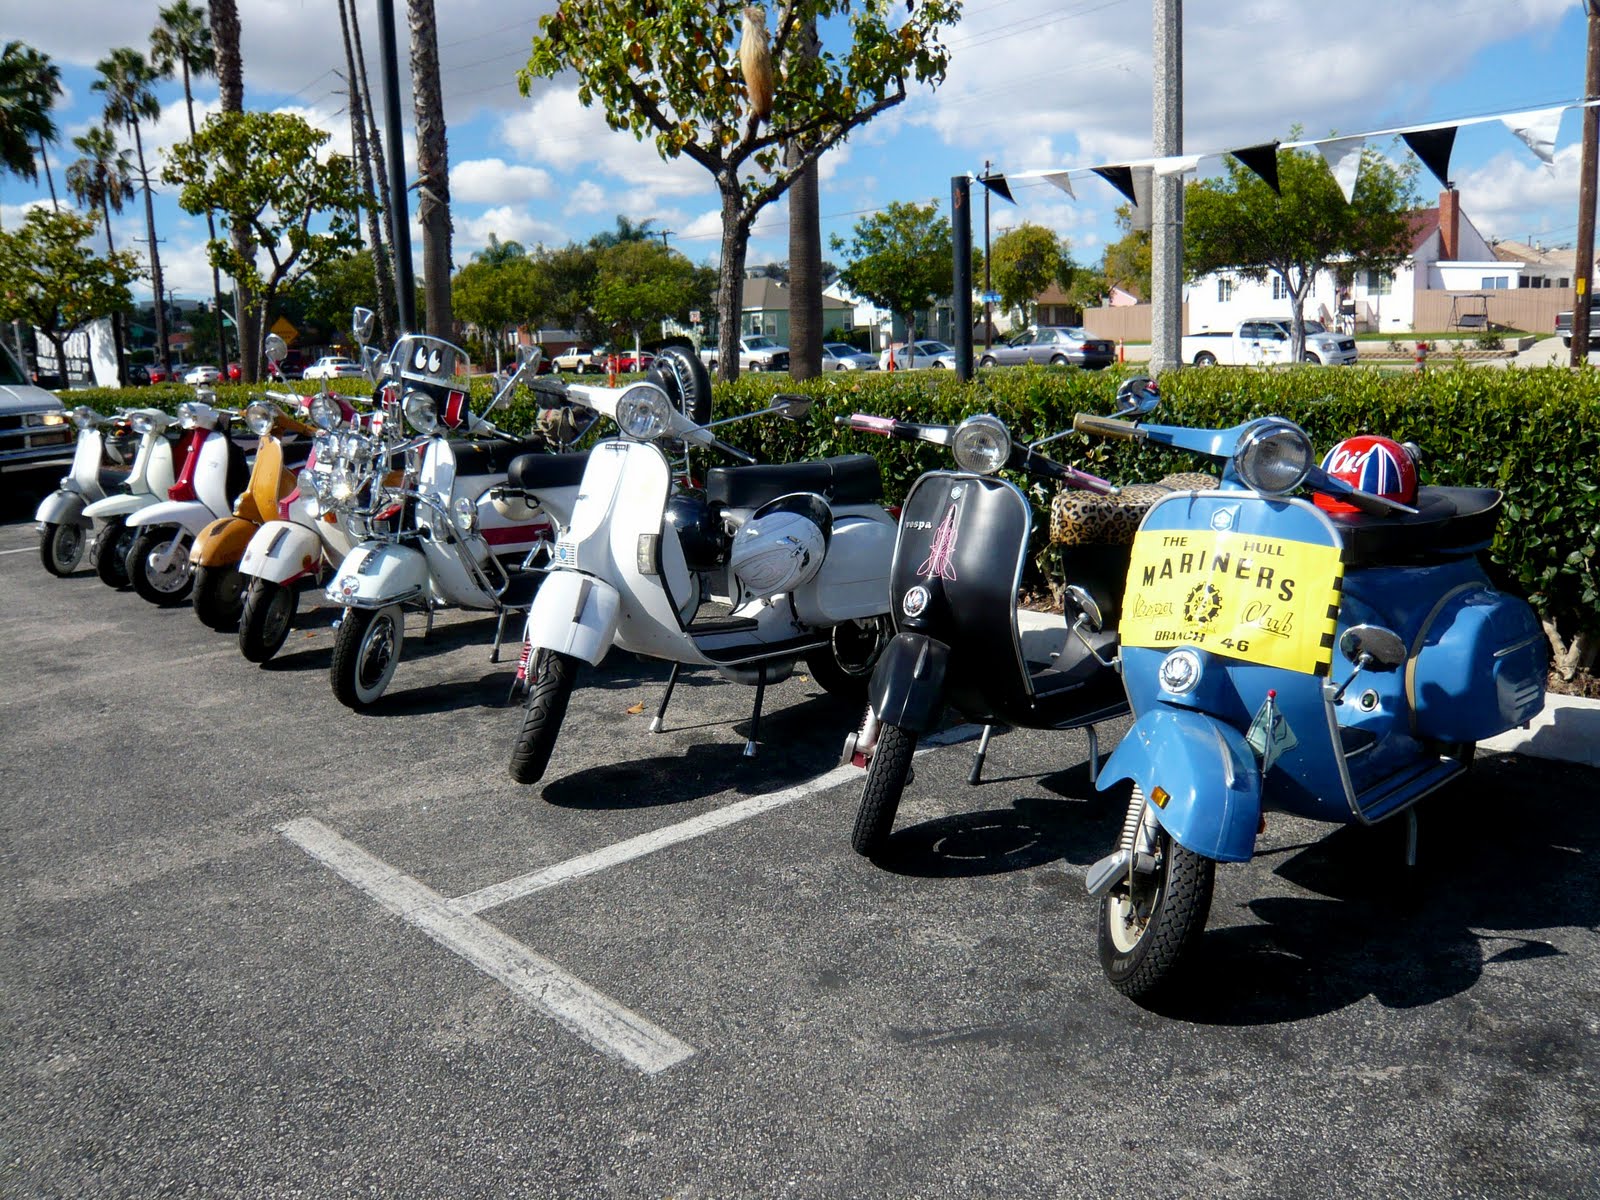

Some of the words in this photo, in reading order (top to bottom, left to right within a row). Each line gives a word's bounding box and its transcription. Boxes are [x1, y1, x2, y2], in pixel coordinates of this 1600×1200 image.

[1330, 449, 1372, 474] Oi!
[1162, 536, 1189, 547] THE
[1243, 541, 1285, 557] HULL
[1142, 550, 1296, 602] MARINERS
[1132, 592, 1174, 622] Vespa
[1241, 600, 1293, 638] Club
[1154, 630, 1206, 643] BRANCH
[1220, 637, 1250, 652] 46
